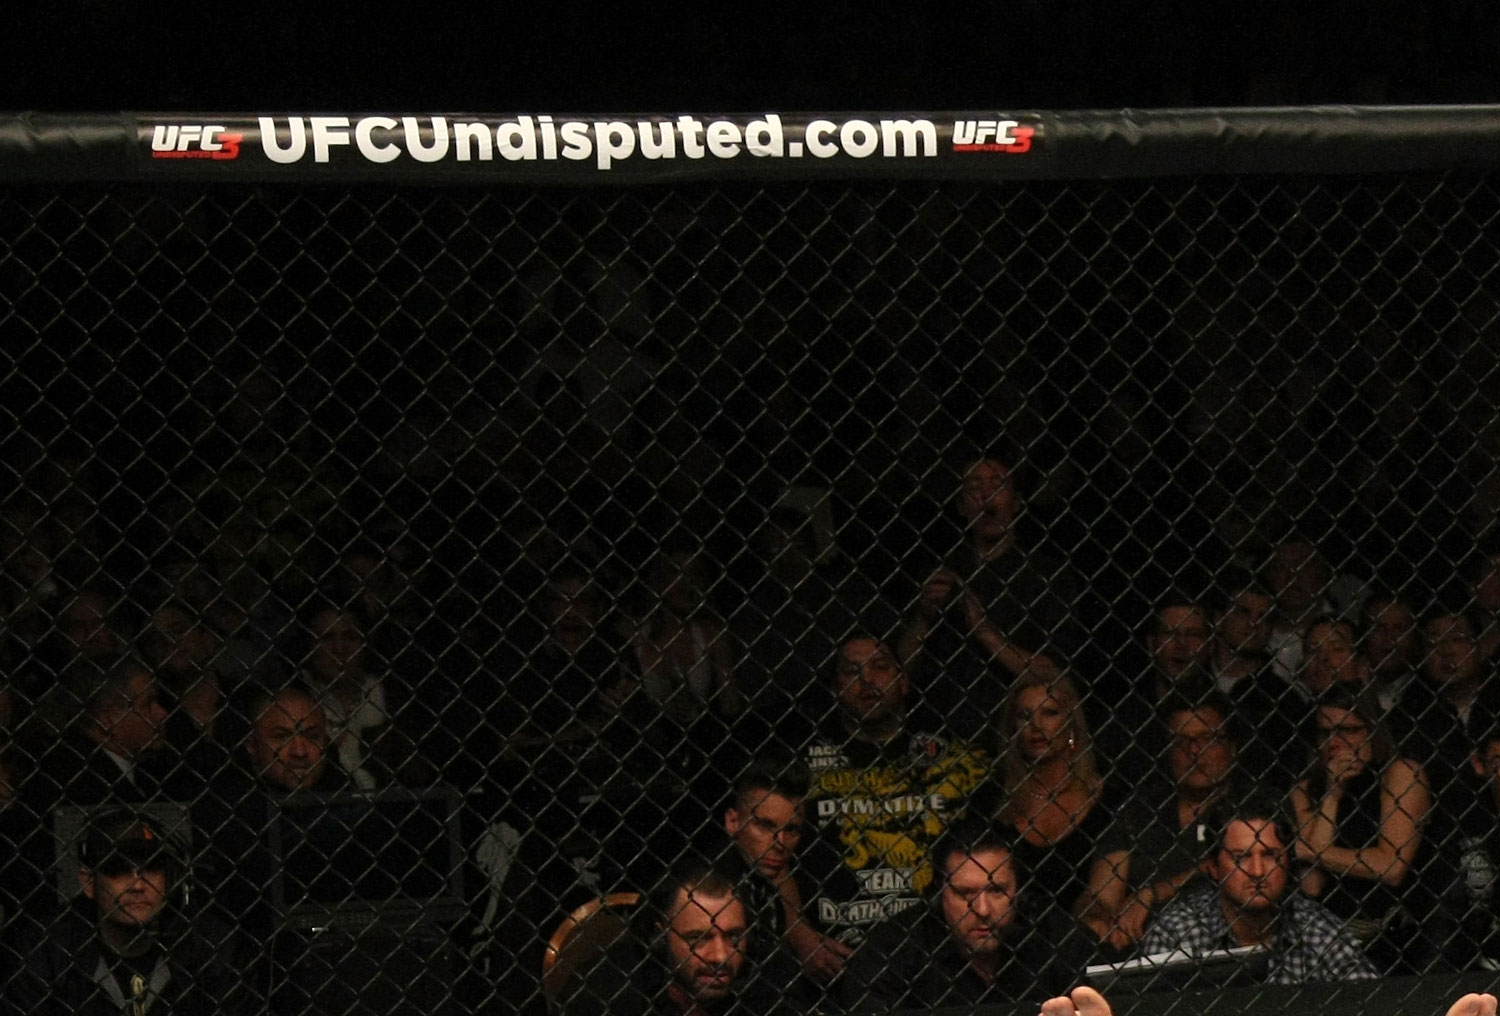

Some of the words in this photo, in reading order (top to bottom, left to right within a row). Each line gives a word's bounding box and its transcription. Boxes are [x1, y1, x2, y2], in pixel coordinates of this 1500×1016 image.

[152, 125, 226, 151] UFC
[258, 113, 938, 169] UFCUndisputed.com
[952, 120, 1019, 145] UFC
